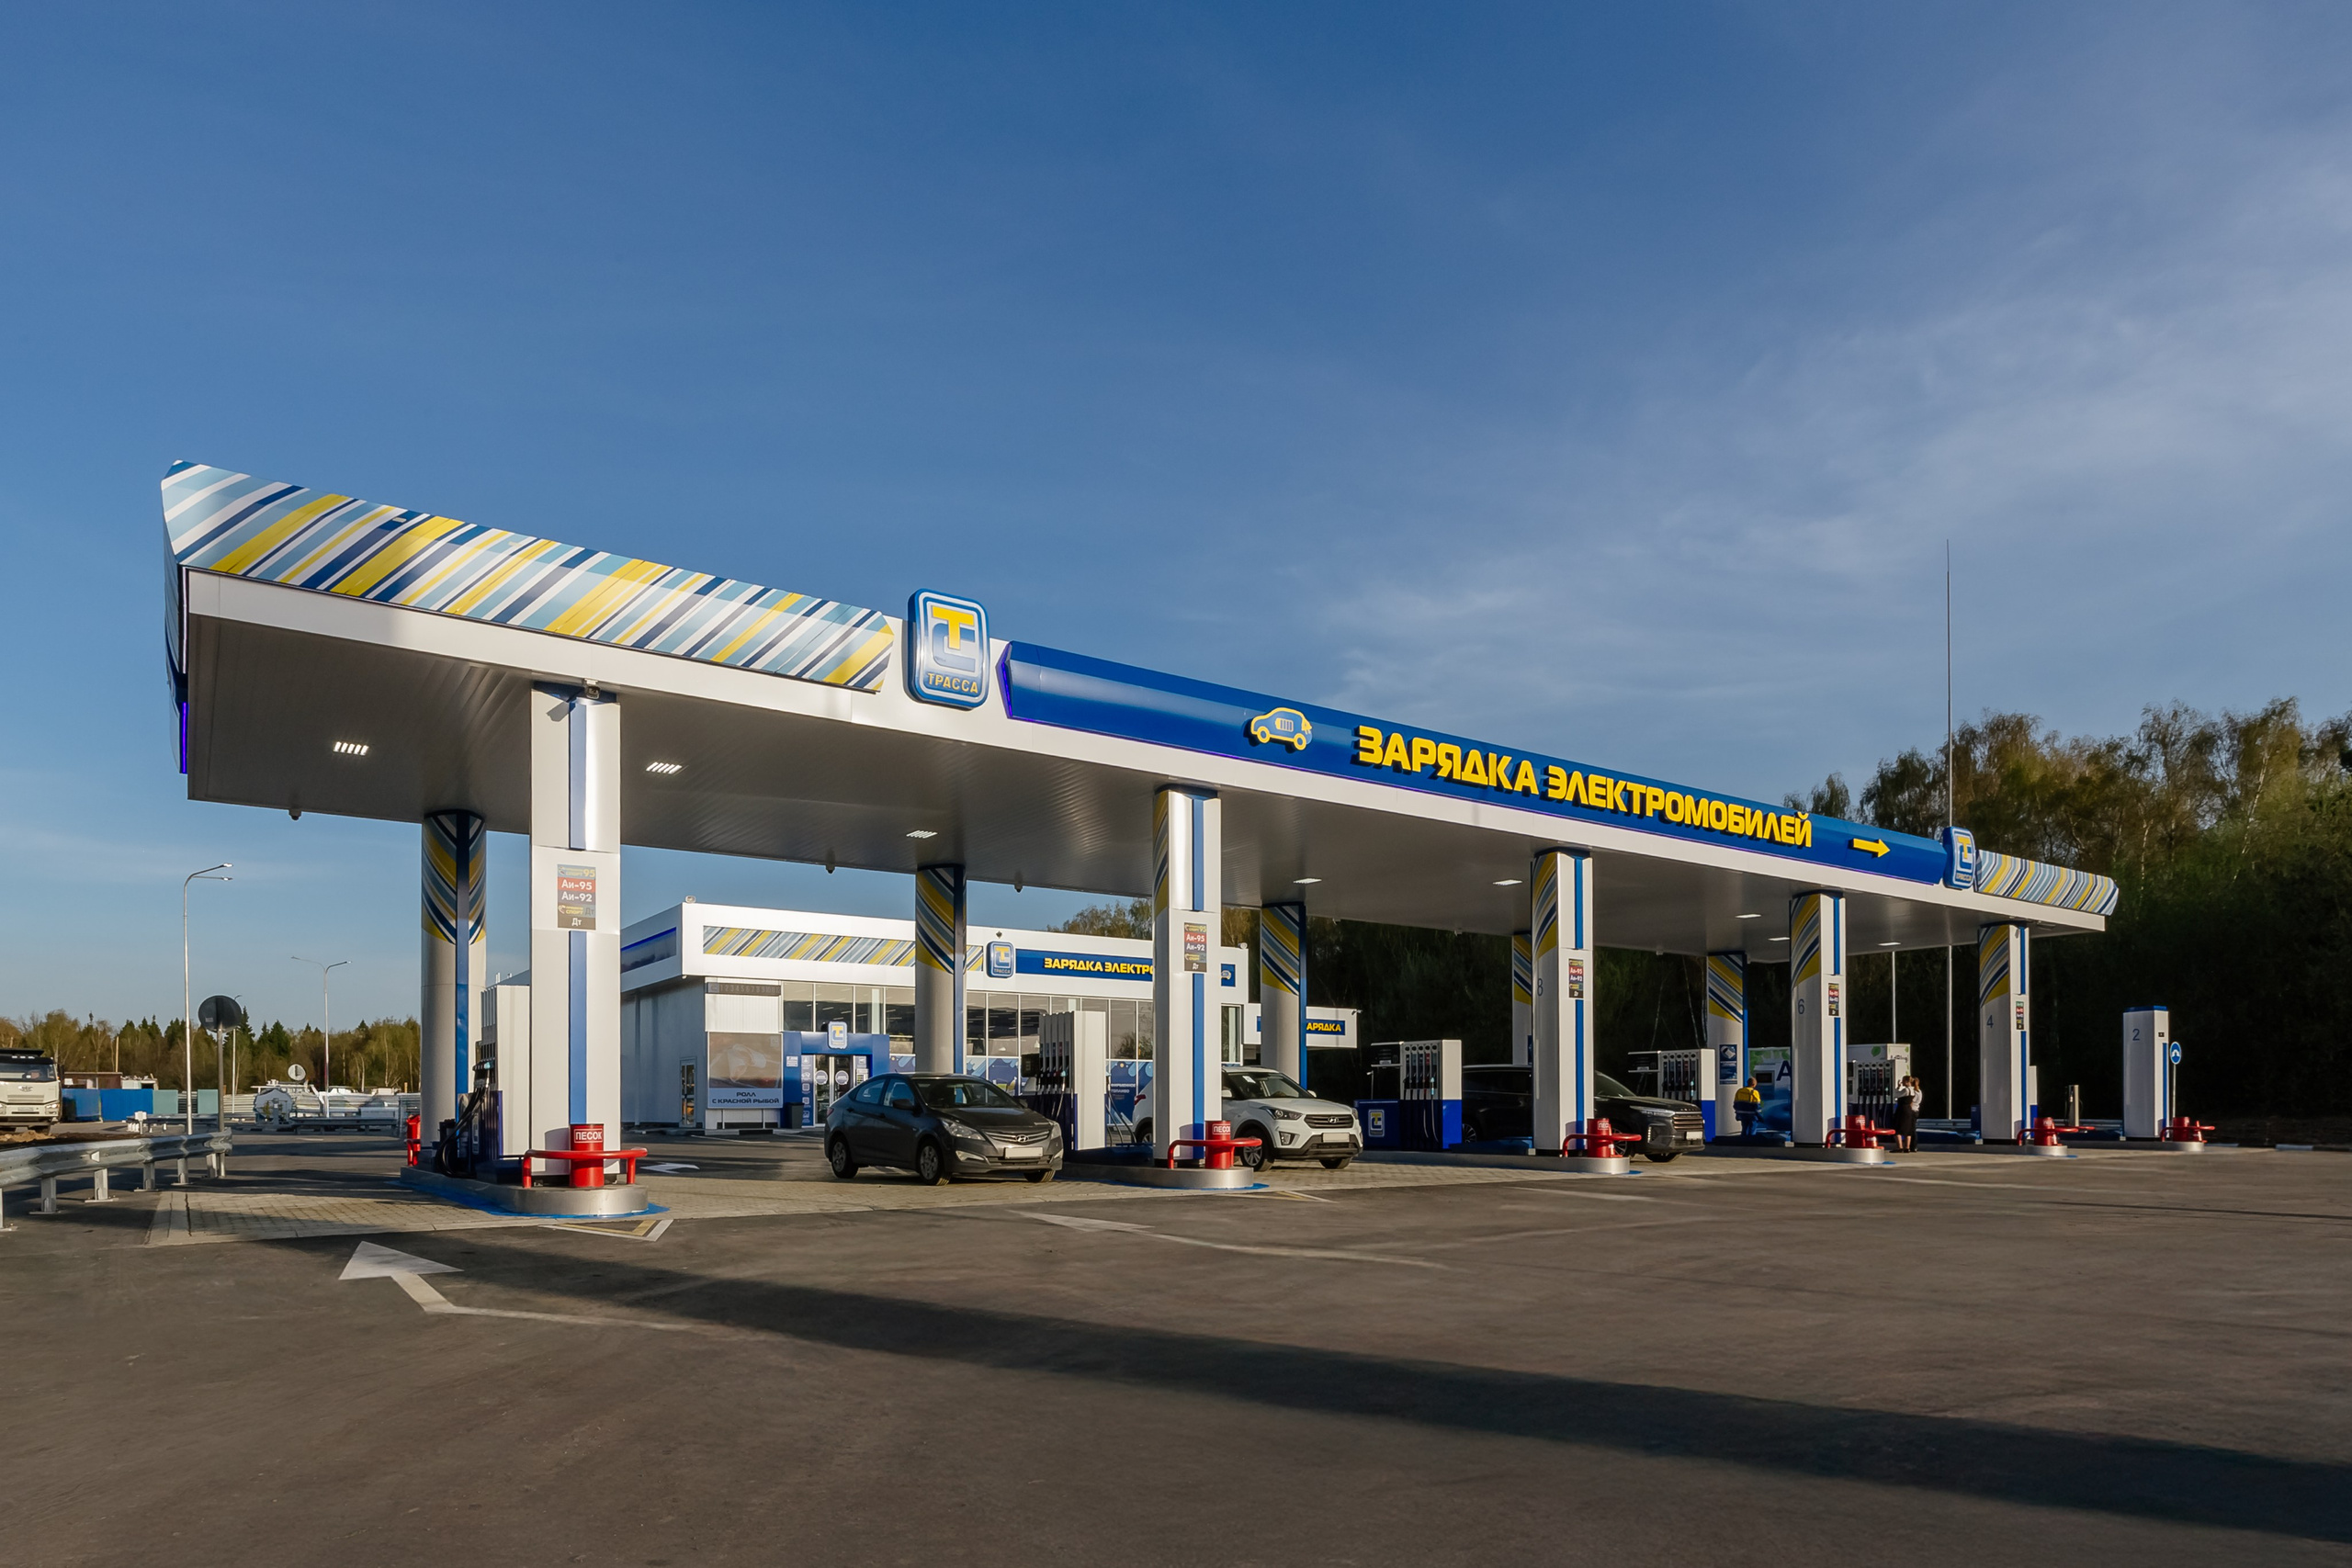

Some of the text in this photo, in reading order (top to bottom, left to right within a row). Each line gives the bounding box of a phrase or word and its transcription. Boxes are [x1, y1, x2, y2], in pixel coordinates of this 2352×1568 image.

[927, 672, 978, 694] ТРАССА
[1360, 725, 1812, 847] ЗАРЯДКА ЭЛЕКТРОМОБИЛЕЙ
[561, 879, 593, 890] Аи-95
[561, 891, 593, 902] Аи-92
[571, 918, 582, 927] Дт
[1045, 958, 1102, 972] ЗАРЯДКА
[1537, 978, 1543, 996] 8
[1797, 998, 1805, 1015] 6
[1306, 1022, 1341, 1032] АРЯДКА
[1986, 1014, 1994, 1029] 4
[2132, 1028, 2141, 1042] 2
[575, 1131, 603, 1141] ПЕСОК
